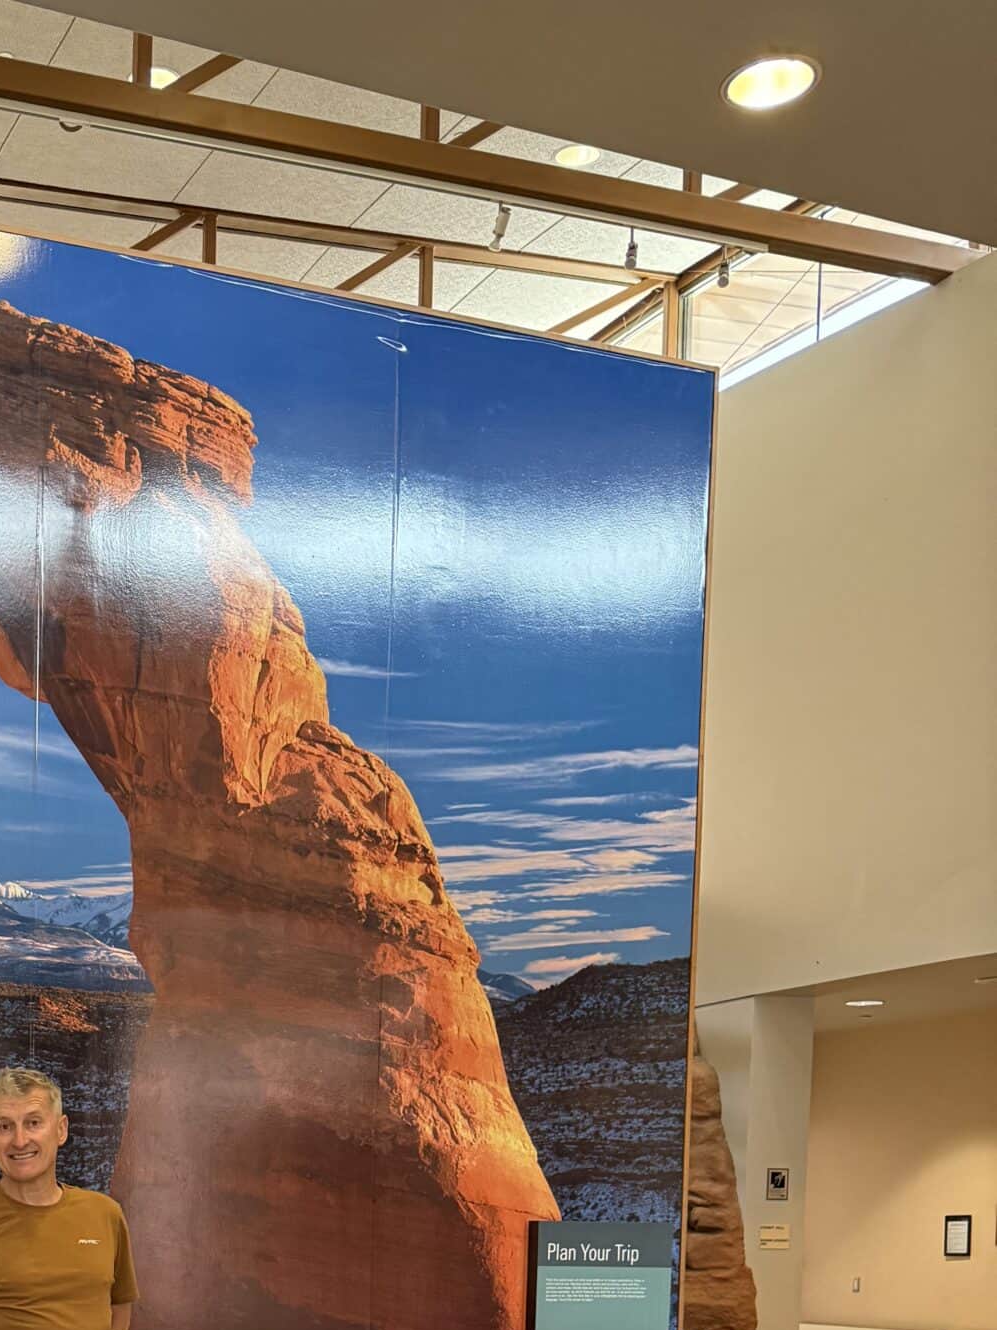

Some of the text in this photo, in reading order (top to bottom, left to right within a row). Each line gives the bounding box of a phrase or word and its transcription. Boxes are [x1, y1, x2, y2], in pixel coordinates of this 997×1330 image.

[547, 1242, 640, 1266] Plan Your Trip
